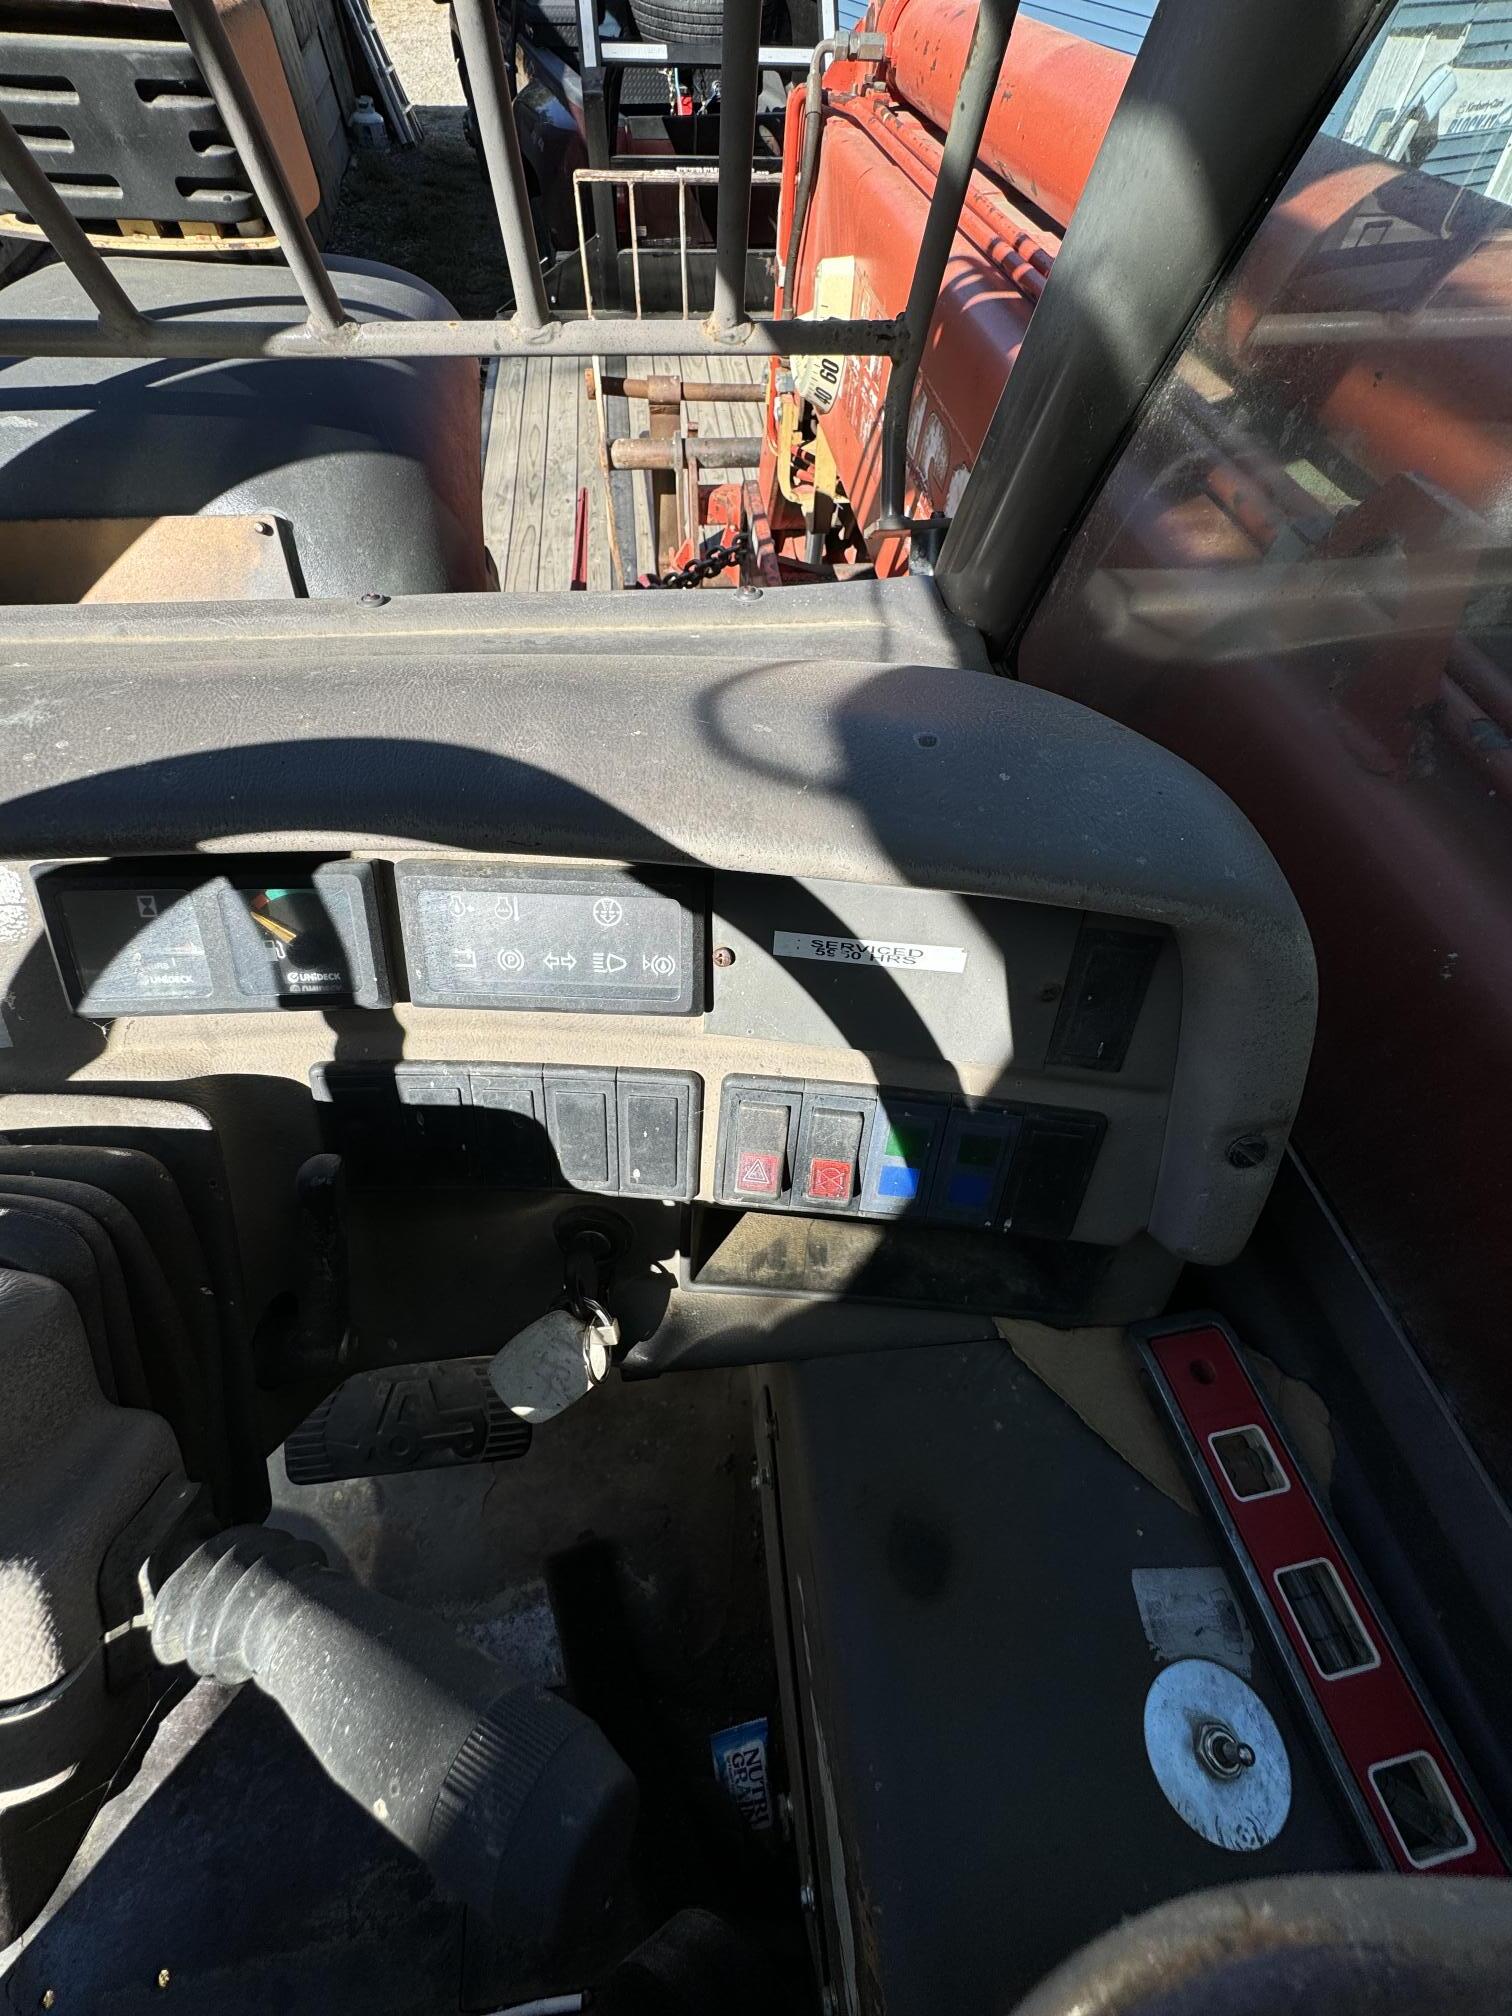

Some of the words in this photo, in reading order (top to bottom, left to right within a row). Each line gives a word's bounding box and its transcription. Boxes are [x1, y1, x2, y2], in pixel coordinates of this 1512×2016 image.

[819, 358, 840, 385] 60
[813, 386, 832, 405] 40
[810, 938, 924, 959] SERVICED
[869, 952, 917, 965] HRS
[299, 972, 342, 982] UNIDECK
[731, 1752, 757, 1824] GRAIN
[743, 1747, 770, 1824] NUTRI
